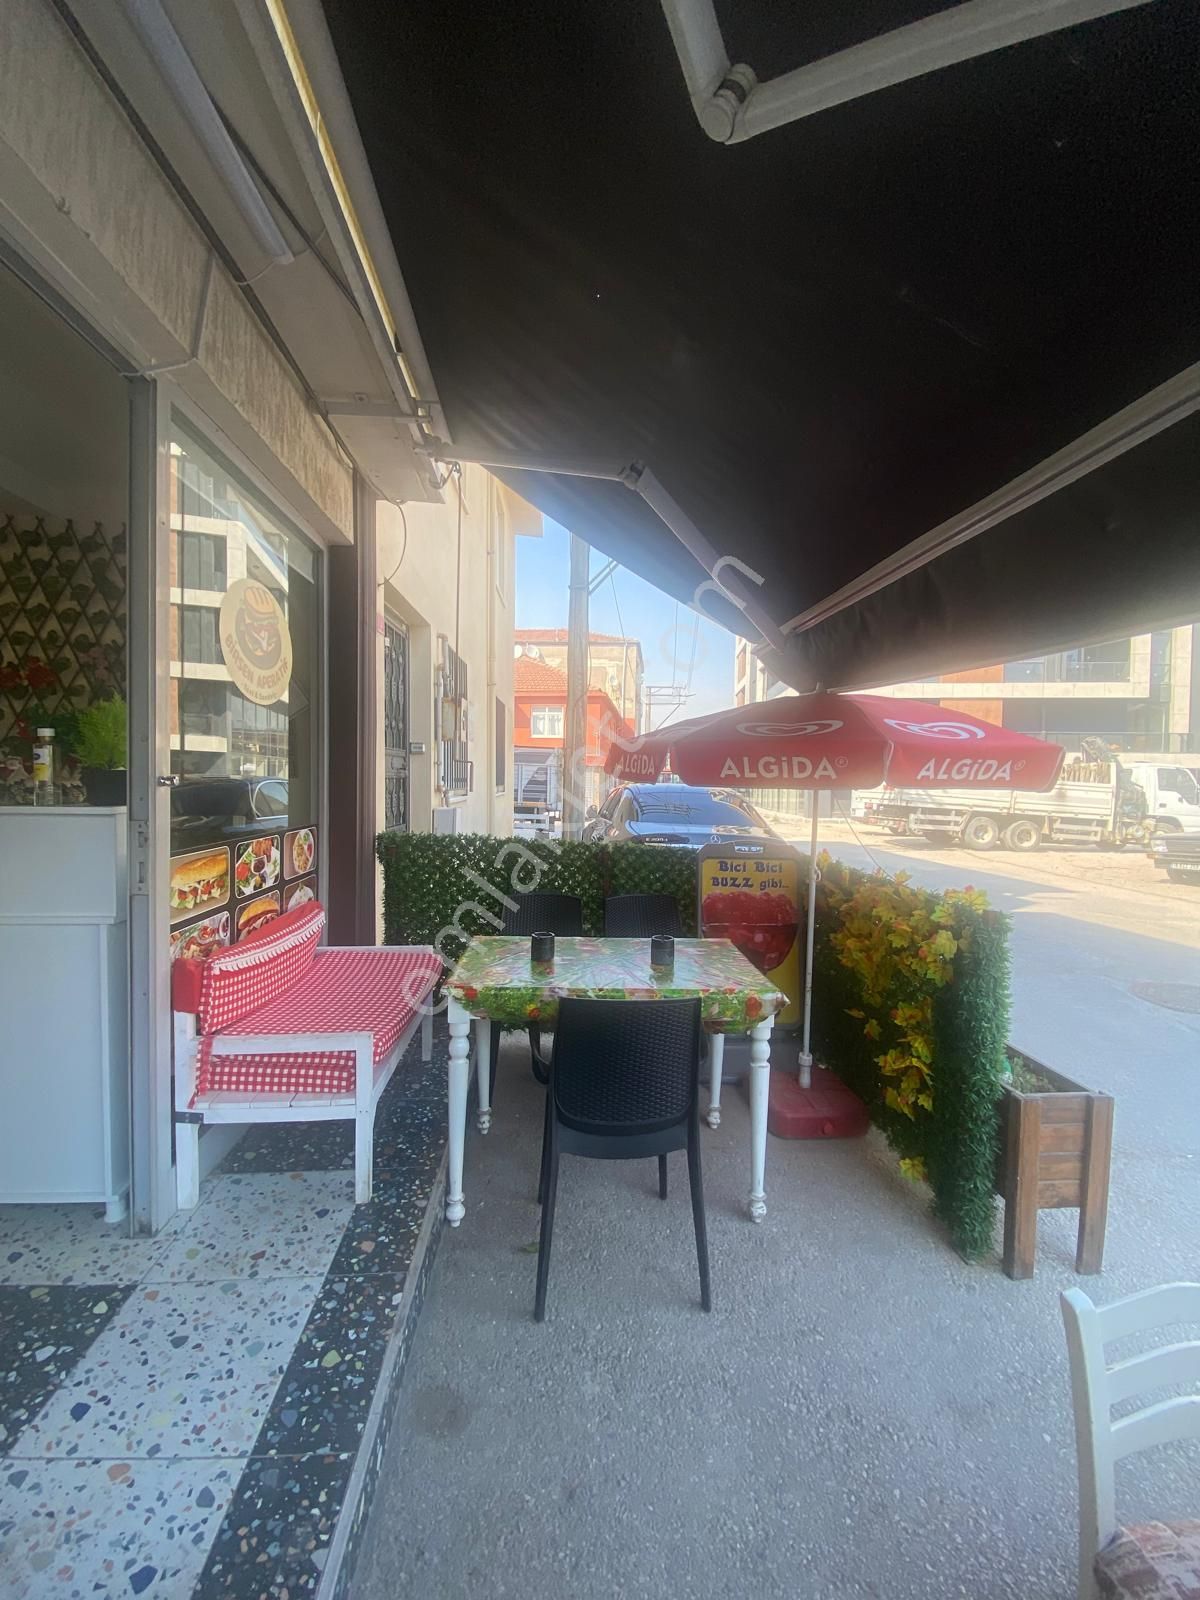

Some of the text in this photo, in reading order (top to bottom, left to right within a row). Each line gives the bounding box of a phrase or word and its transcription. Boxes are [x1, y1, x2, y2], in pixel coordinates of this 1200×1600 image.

[718, 859, 784, 873] Bici Bici
[711, 876, 754, 889] BUZZ
